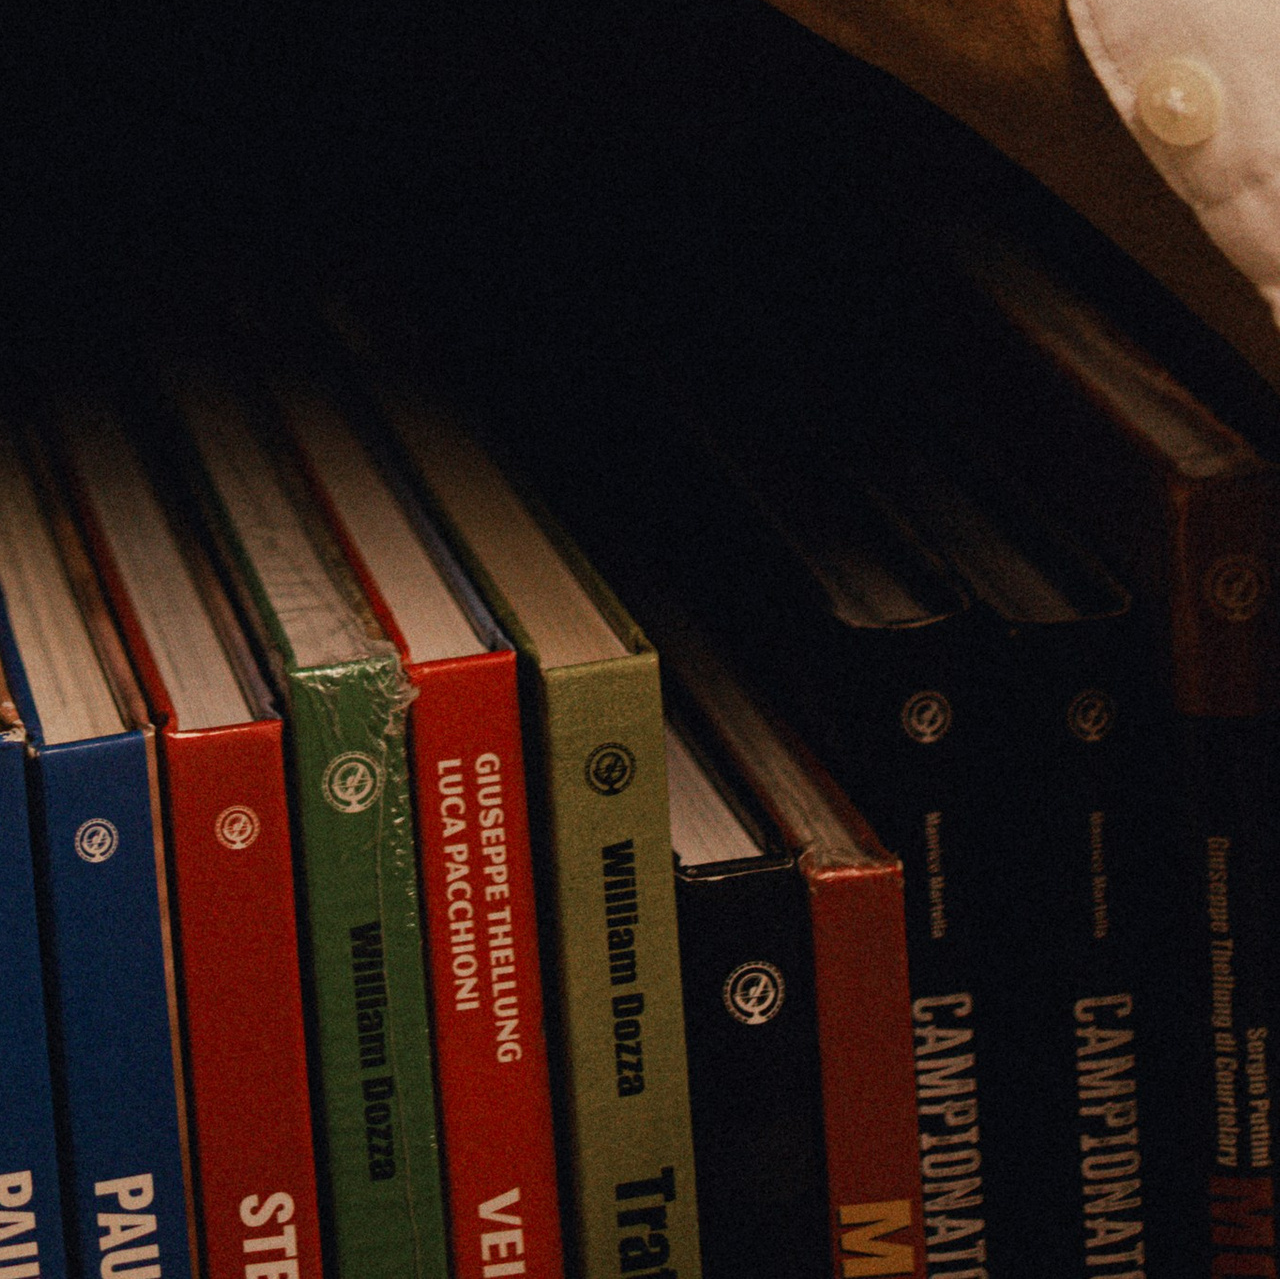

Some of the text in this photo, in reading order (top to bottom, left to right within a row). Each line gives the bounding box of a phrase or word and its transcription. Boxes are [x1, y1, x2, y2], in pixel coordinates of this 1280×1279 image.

[437, 758, 480, 1012] LUCA PACCHIONI
[475, 753, 522, 1065] GIUSEPPE THELLUNG
[601, 838, 646, 1098] William Dozza
[349, 920, 396, 1182] William Dozza
[1073, 993, 1148, 1279] CAMPIONAT
